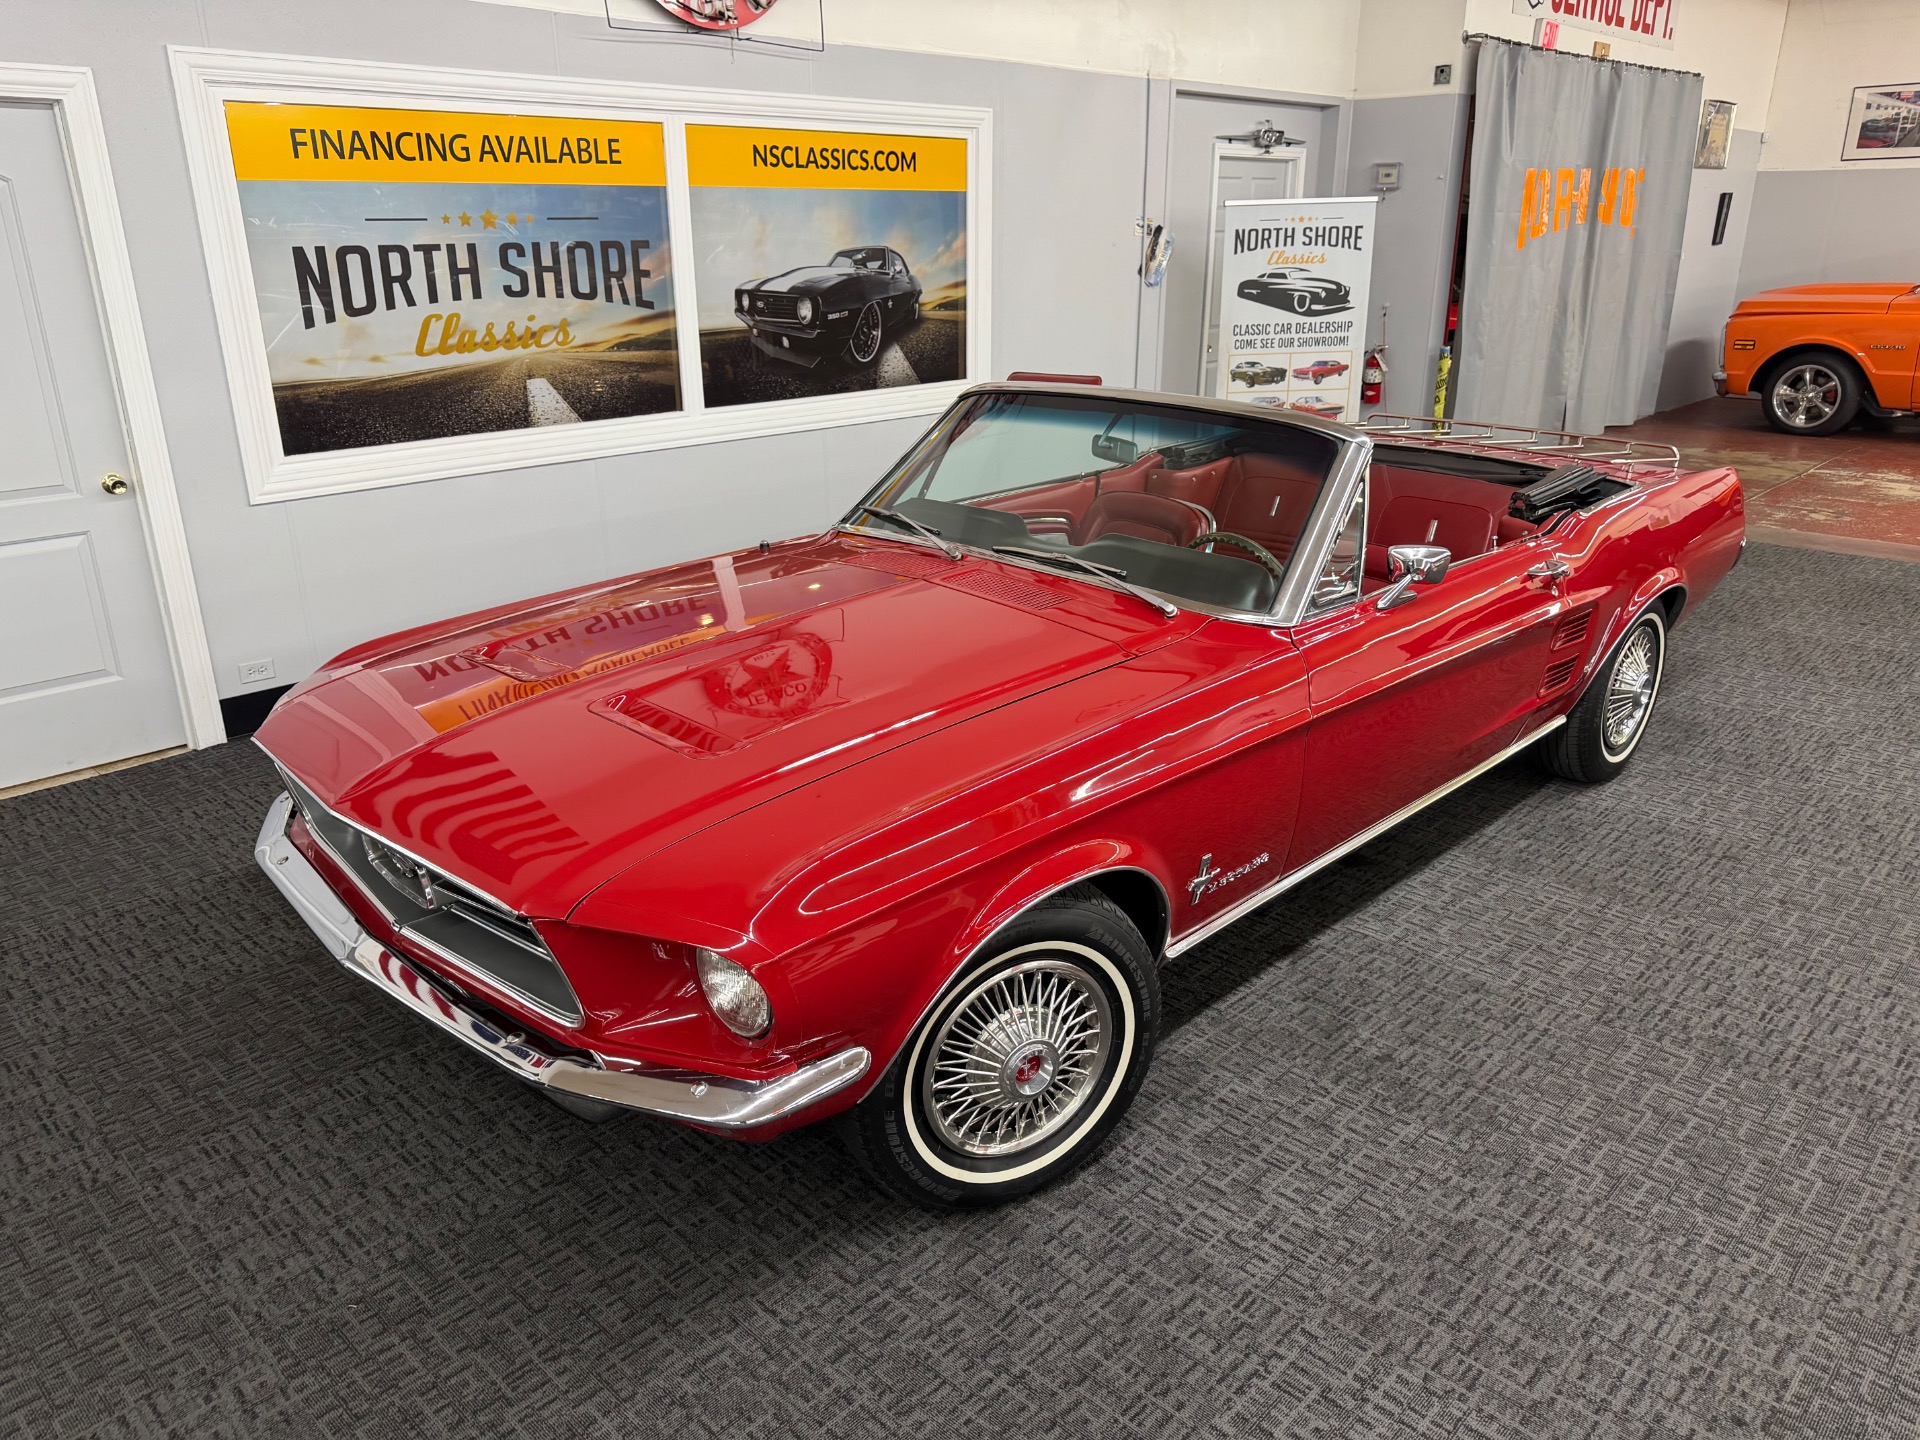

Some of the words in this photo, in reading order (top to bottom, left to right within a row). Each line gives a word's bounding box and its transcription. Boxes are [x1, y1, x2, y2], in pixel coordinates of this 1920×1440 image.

[289, 128, 471, 163] FINANCING
[479, 135, 622, 165] AVAILABLE
[752, 144, 917, 173] NSCLASSICS.COM
[1233, 227, 1296, 255] NORTH
[1302, 225, 1364, 251] SHORE
[1266, 250, 1327, 266] Classics
[292, 242, 482, 329] NORTH
[499, 239, 655, 310] SHORE
[415, 312, 577, 358] Classics
[1233, 323, 1271, 336] CLASSIC
[1273, 322, 1292, 335] CAR
[1295, 320, 1354, 335] DEALERSHIP
[1234, 338, 1258, 350] COME
[1260, 338, 1275, 349] SEE
[1277, 337, 1295, 348] OUR
[1297, 335, 1349, 348] SHOWROOM!
[1085, 926, 1151, 1021] BRIDGESTONE
[883, 1110, 960, 1202] BRIDGESTONE
